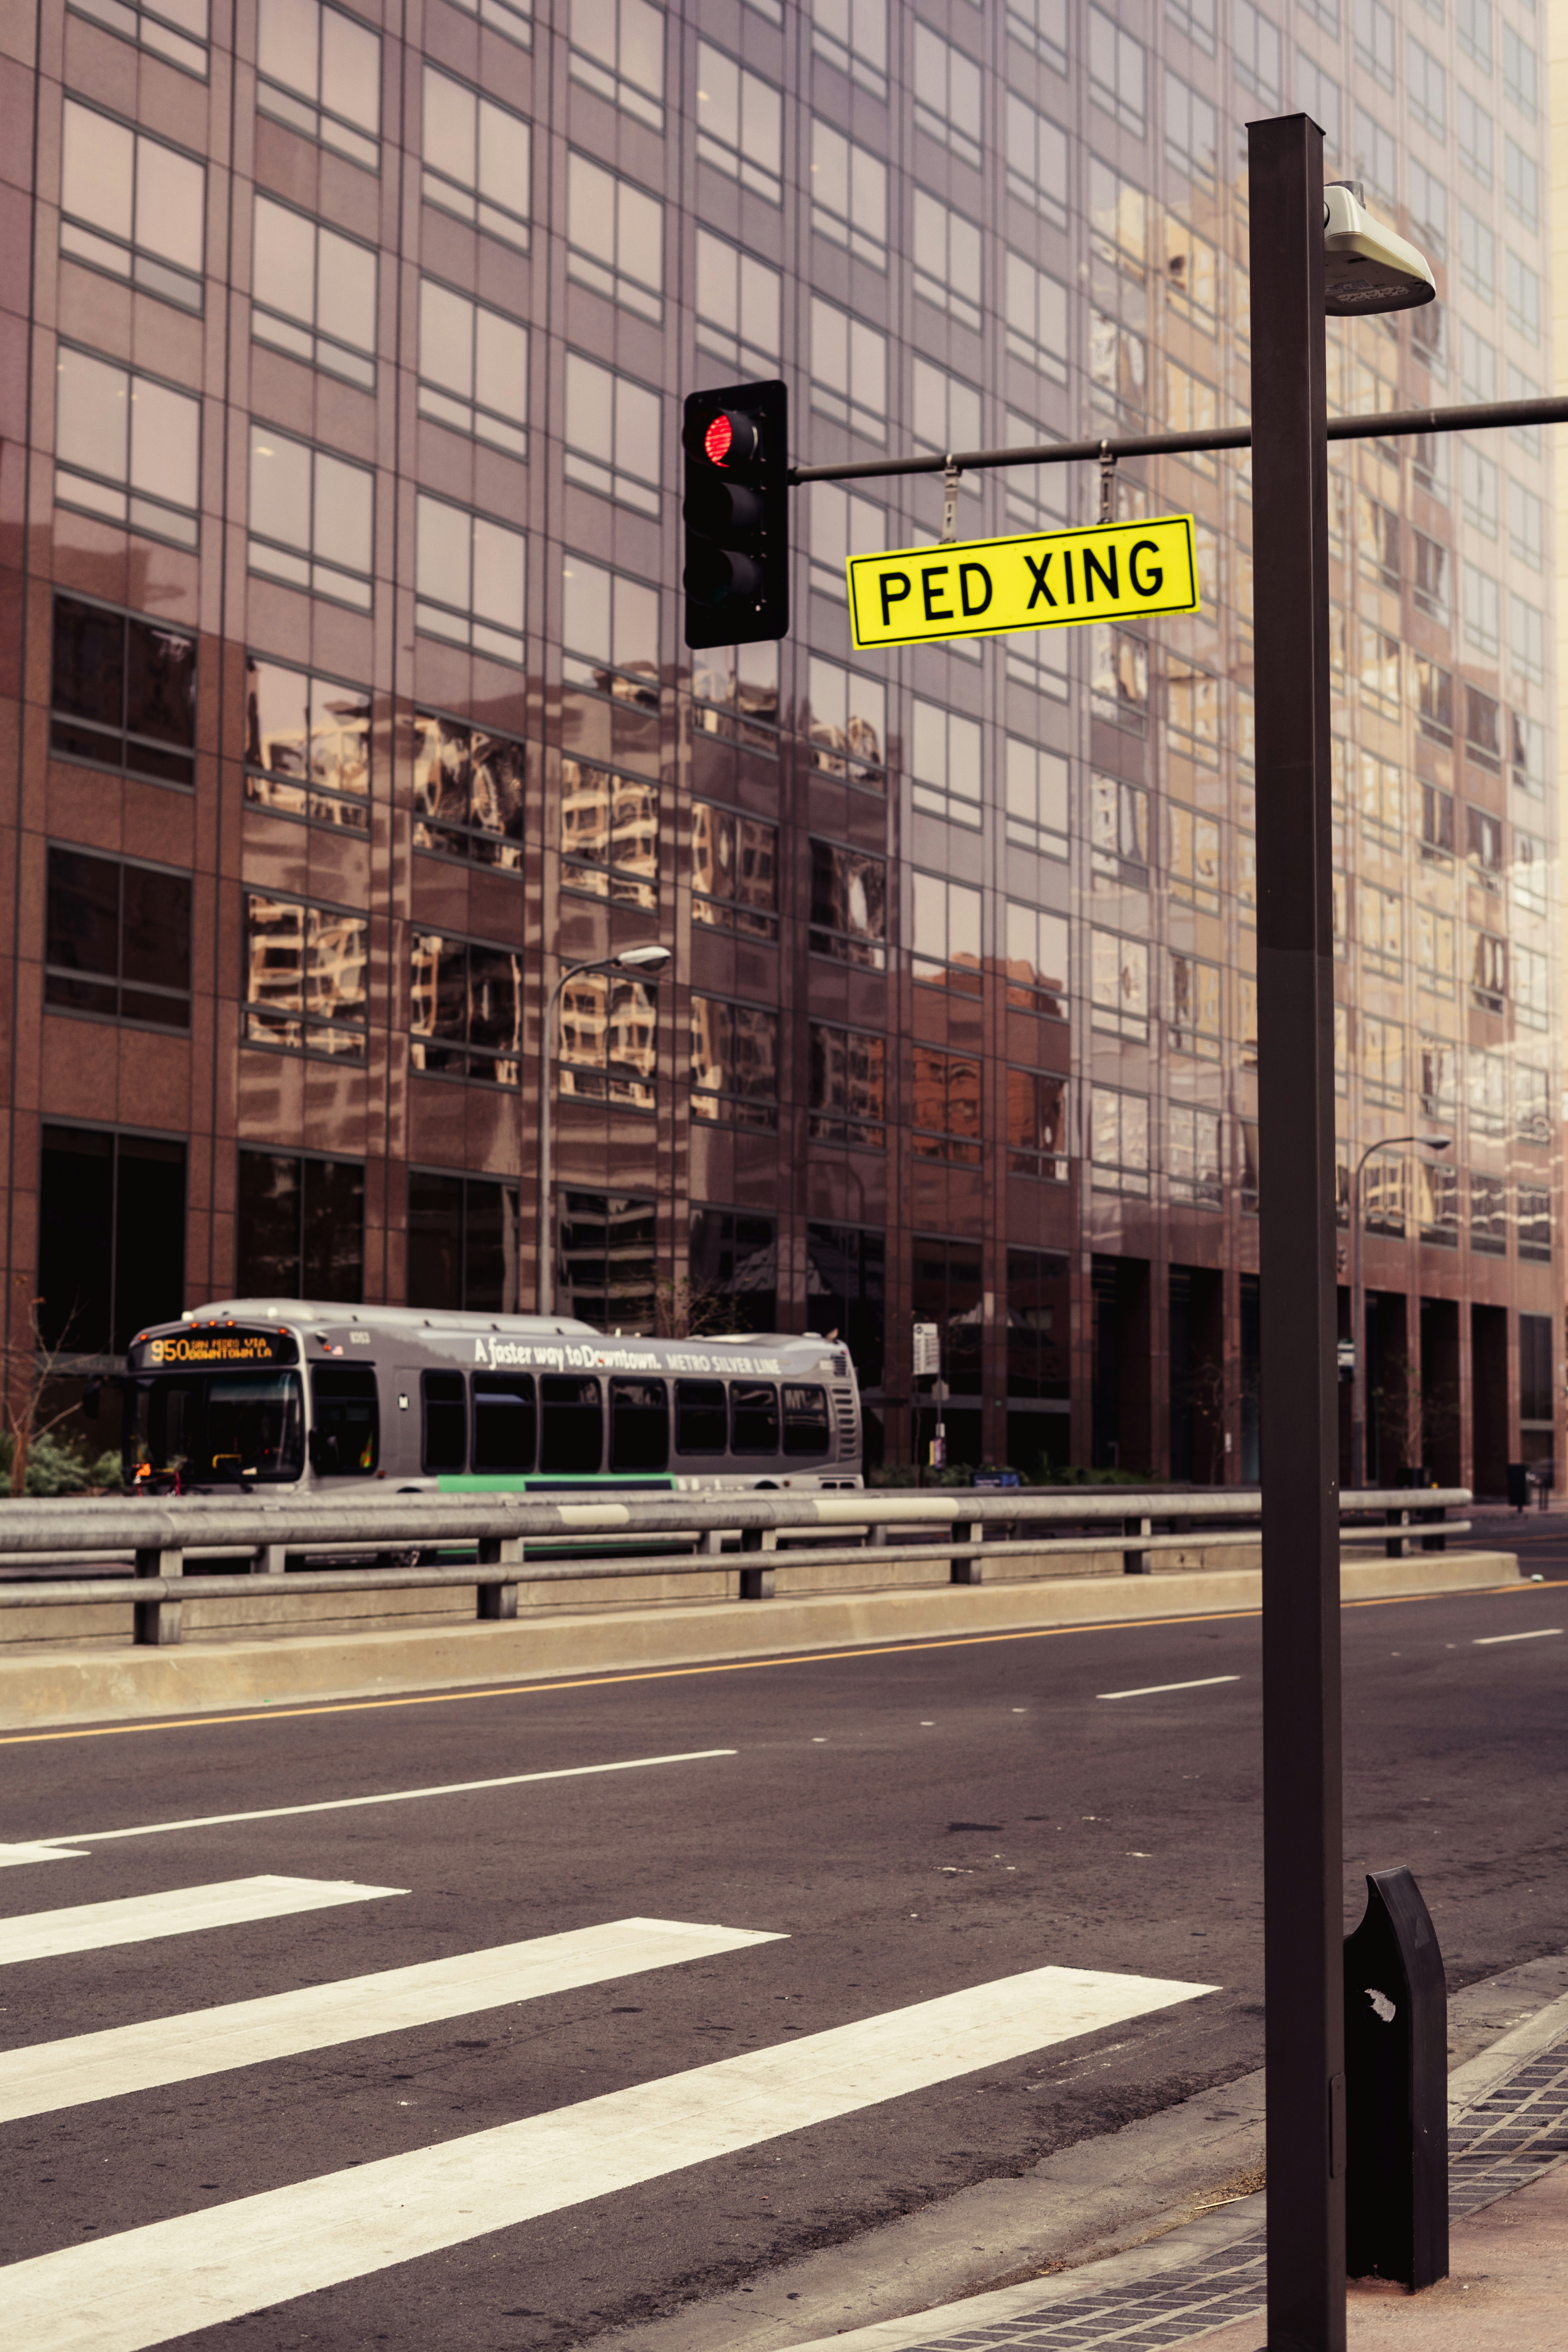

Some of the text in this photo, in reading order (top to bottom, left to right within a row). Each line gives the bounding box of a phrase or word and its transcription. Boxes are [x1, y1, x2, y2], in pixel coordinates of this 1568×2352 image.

[879, 540, 1163, 626] PED XING
[151, 1339, 189, 1361] 950
[188, 1347, 272, 1360] DOWNTOWN LA
[244, 1337, 267, 1348] VIA
[474, 1338, 488, 1362] A
[488, 1336, 532, 1370] faster
[533, 1346, 564, 1372] way
[565, 1344, 583, 1366] to
[665, 1353, 711, 1372] METRO
[711, 1355, 753, 1374] SILVER
[752, 1357, 782, 1375] LINE
